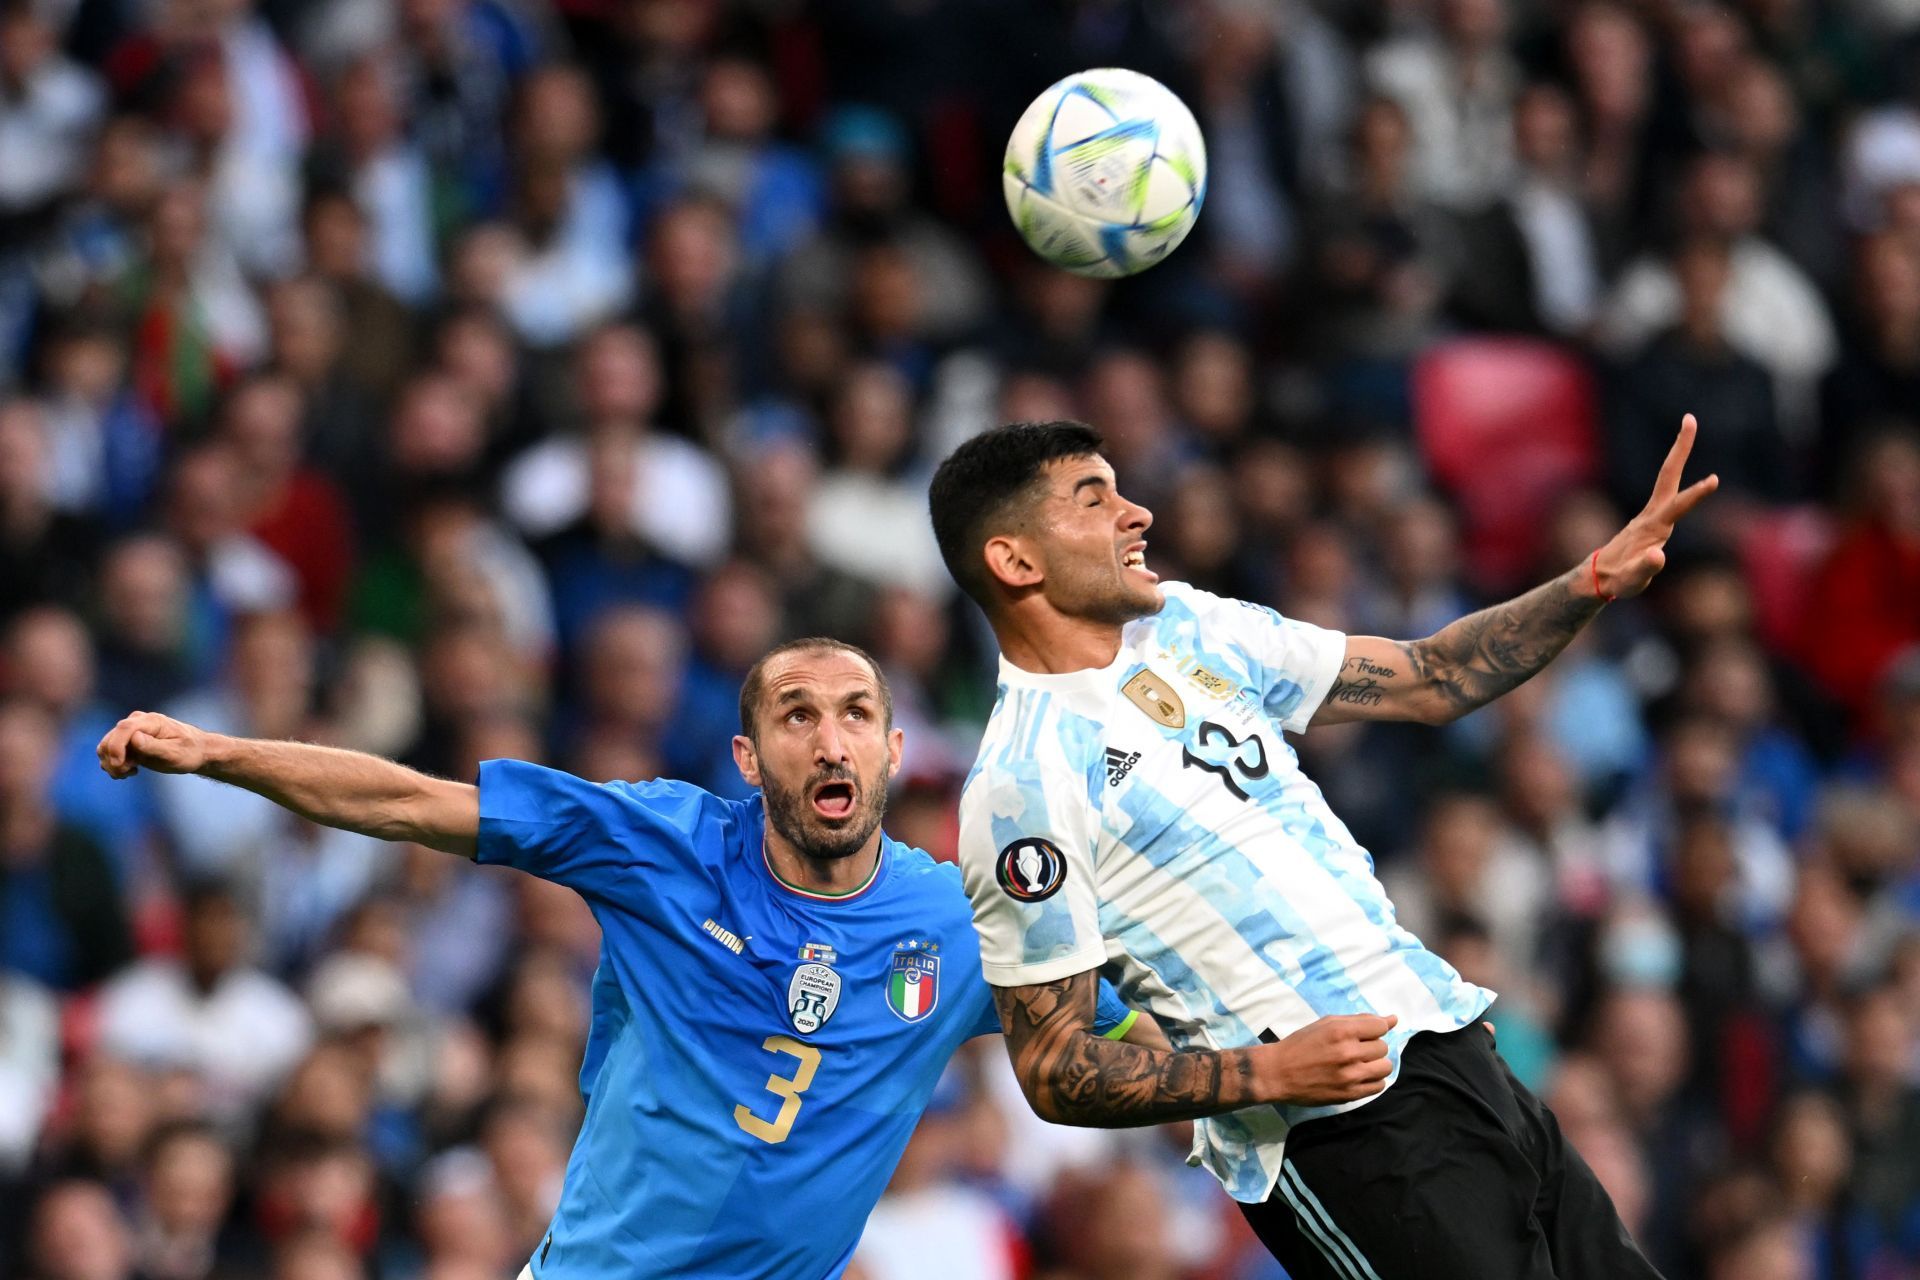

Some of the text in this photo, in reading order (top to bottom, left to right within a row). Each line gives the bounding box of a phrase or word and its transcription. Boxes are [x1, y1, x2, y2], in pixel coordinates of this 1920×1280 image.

[1349, 657, 1397, 678] Franco
[1327, 677, 1386, 706] Victor
[1109, 751, 1142, 787] adidas
[1182, 720, 1270, 803] 13
[702, 918, 745, 955] PUMA
[894, 957, 935, 971] ITALIA
[799, 980, 833, 994] CHAMPIONS
[800, 974, 835, 989] EUROPEAN
[797, 1017, 815, 1028] 2020
[733, 1034, 823, 1145] 3
